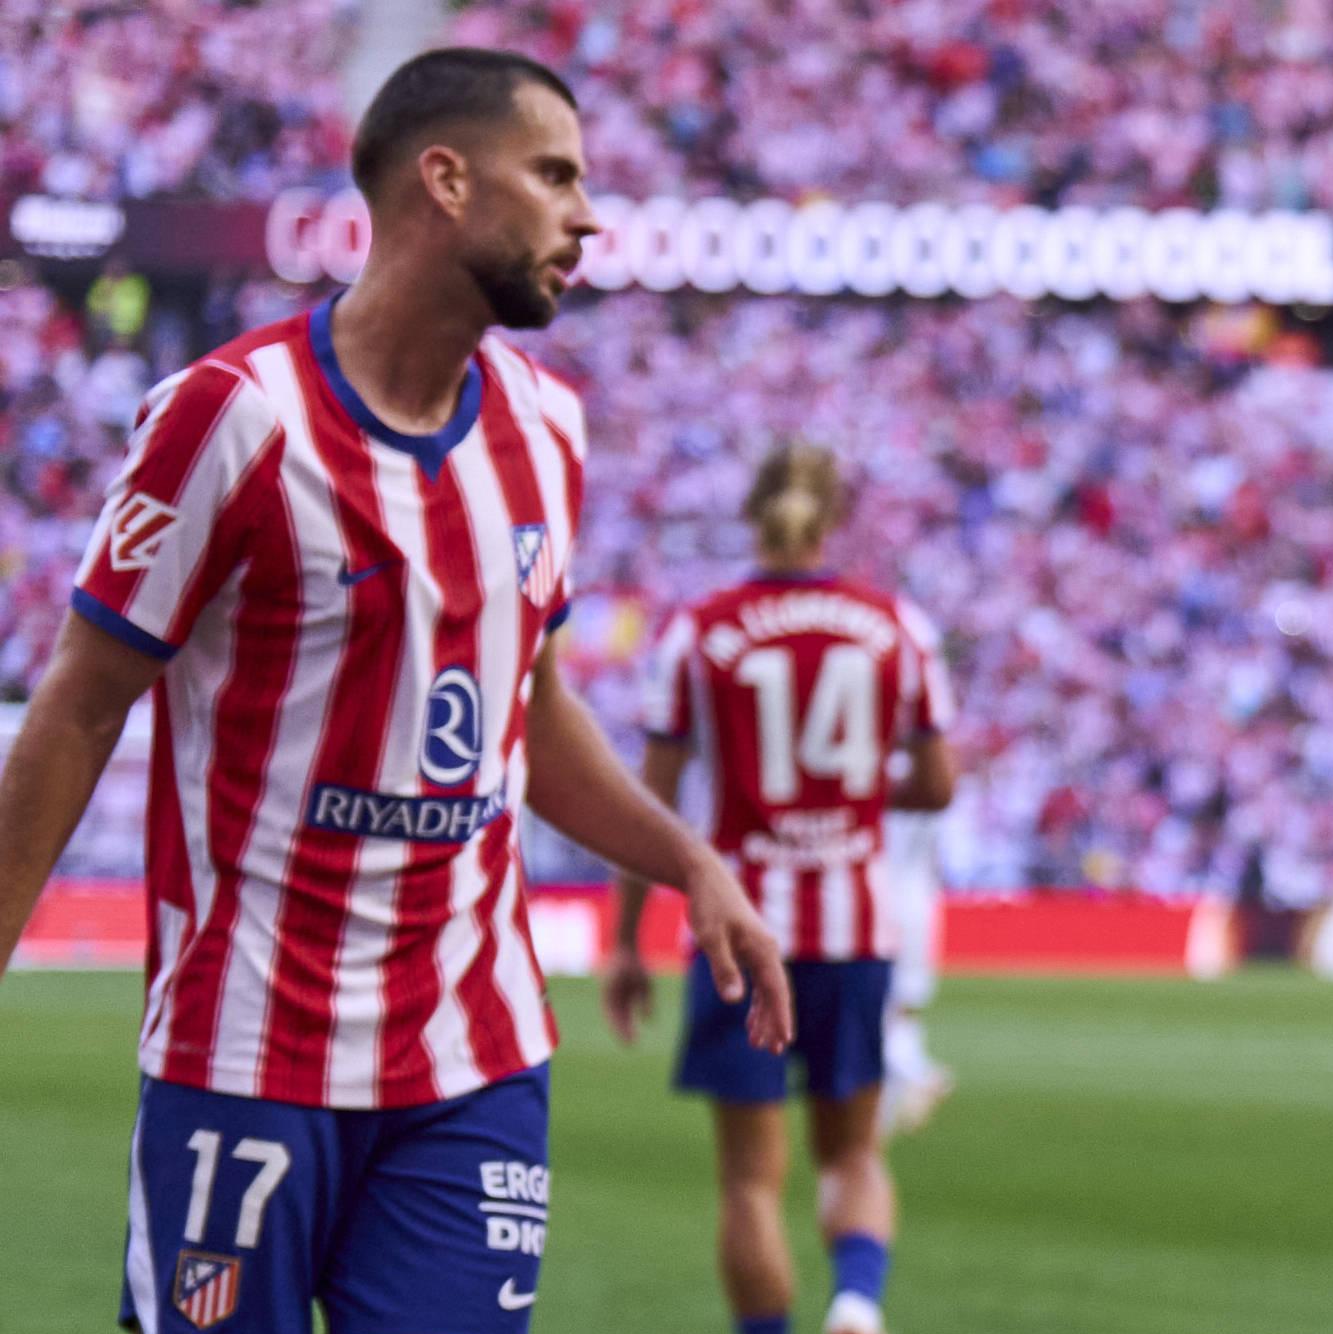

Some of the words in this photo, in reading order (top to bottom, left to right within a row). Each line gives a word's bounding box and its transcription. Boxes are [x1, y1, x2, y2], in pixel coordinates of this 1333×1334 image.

[734, 643, 883, 805] 14
[315, 787, 477, 839] RIYADH
[186, 1129, 291, 1249] 17
[487, 1217, 546, 1257] DK
